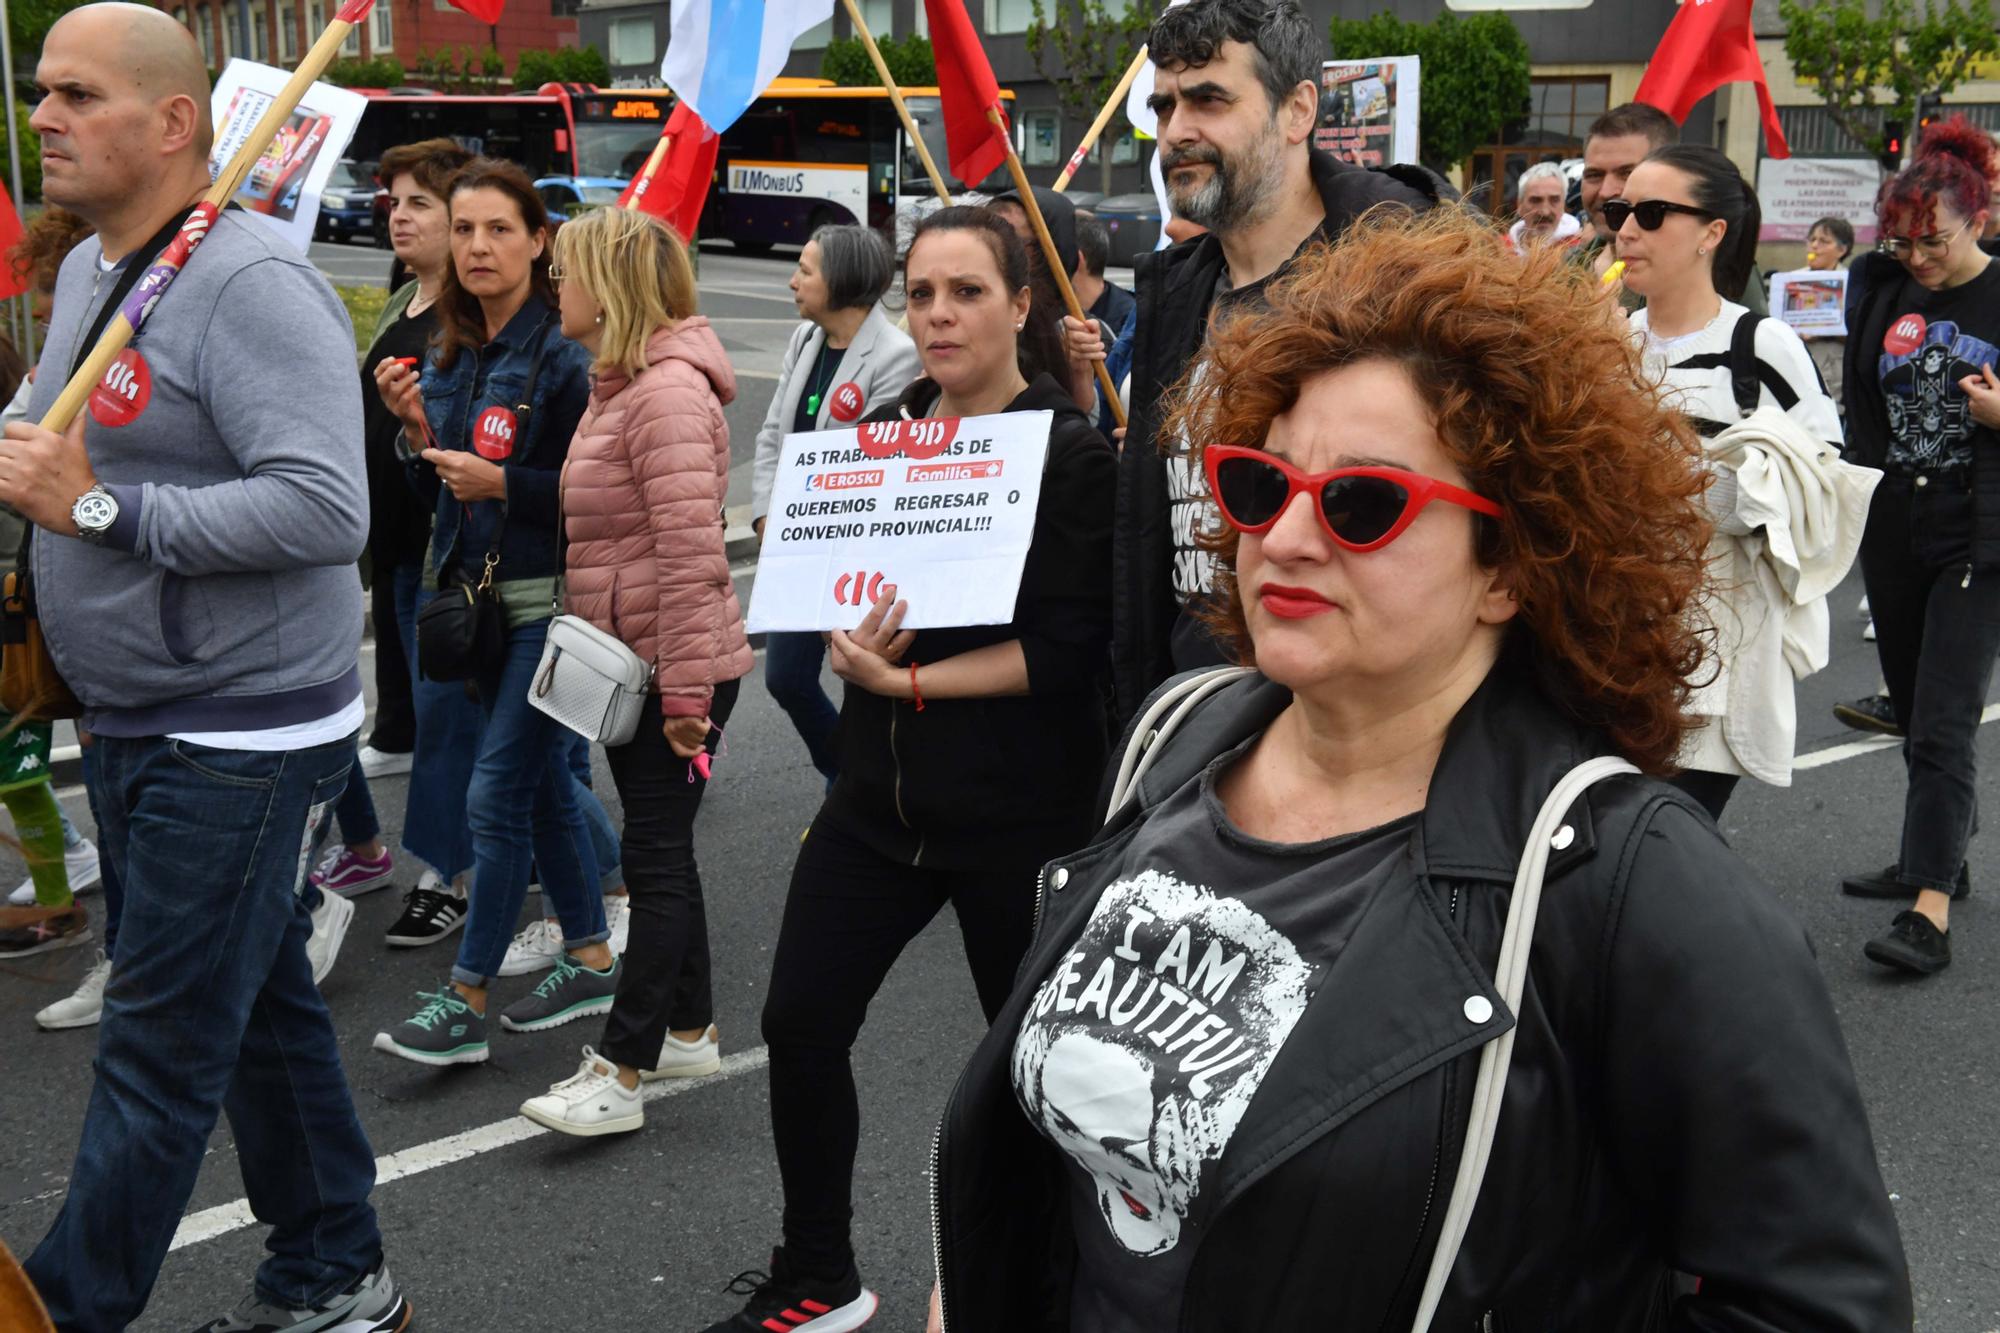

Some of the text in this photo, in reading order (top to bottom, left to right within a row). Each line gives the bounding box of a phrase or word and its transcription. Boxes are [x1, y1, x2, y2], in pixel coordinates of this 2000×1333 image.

[1896, 320, 1919, 340] CIG
[105, 361, 140, 401] CIG
[839, 387, 858, 410] CIG
[483, 414, 513, 441] CIG
[795, 452, 816, 468] AS
[969, 438, 993, 456] DE
[827, 472, 881, 488] EROSKI
[909, 466, 972, 482] Familia
[785, 489, 1020, 518] QUEREMOS REGRESAR O
[780, 516, 993, 541] CONVENIO PROVINCIAL!!!
[834, 571, 897, 607] CIG
[1115, 905, 1246, 1006] I AM
[1036, 952, 1256, 1100] BEAUTIFUL
